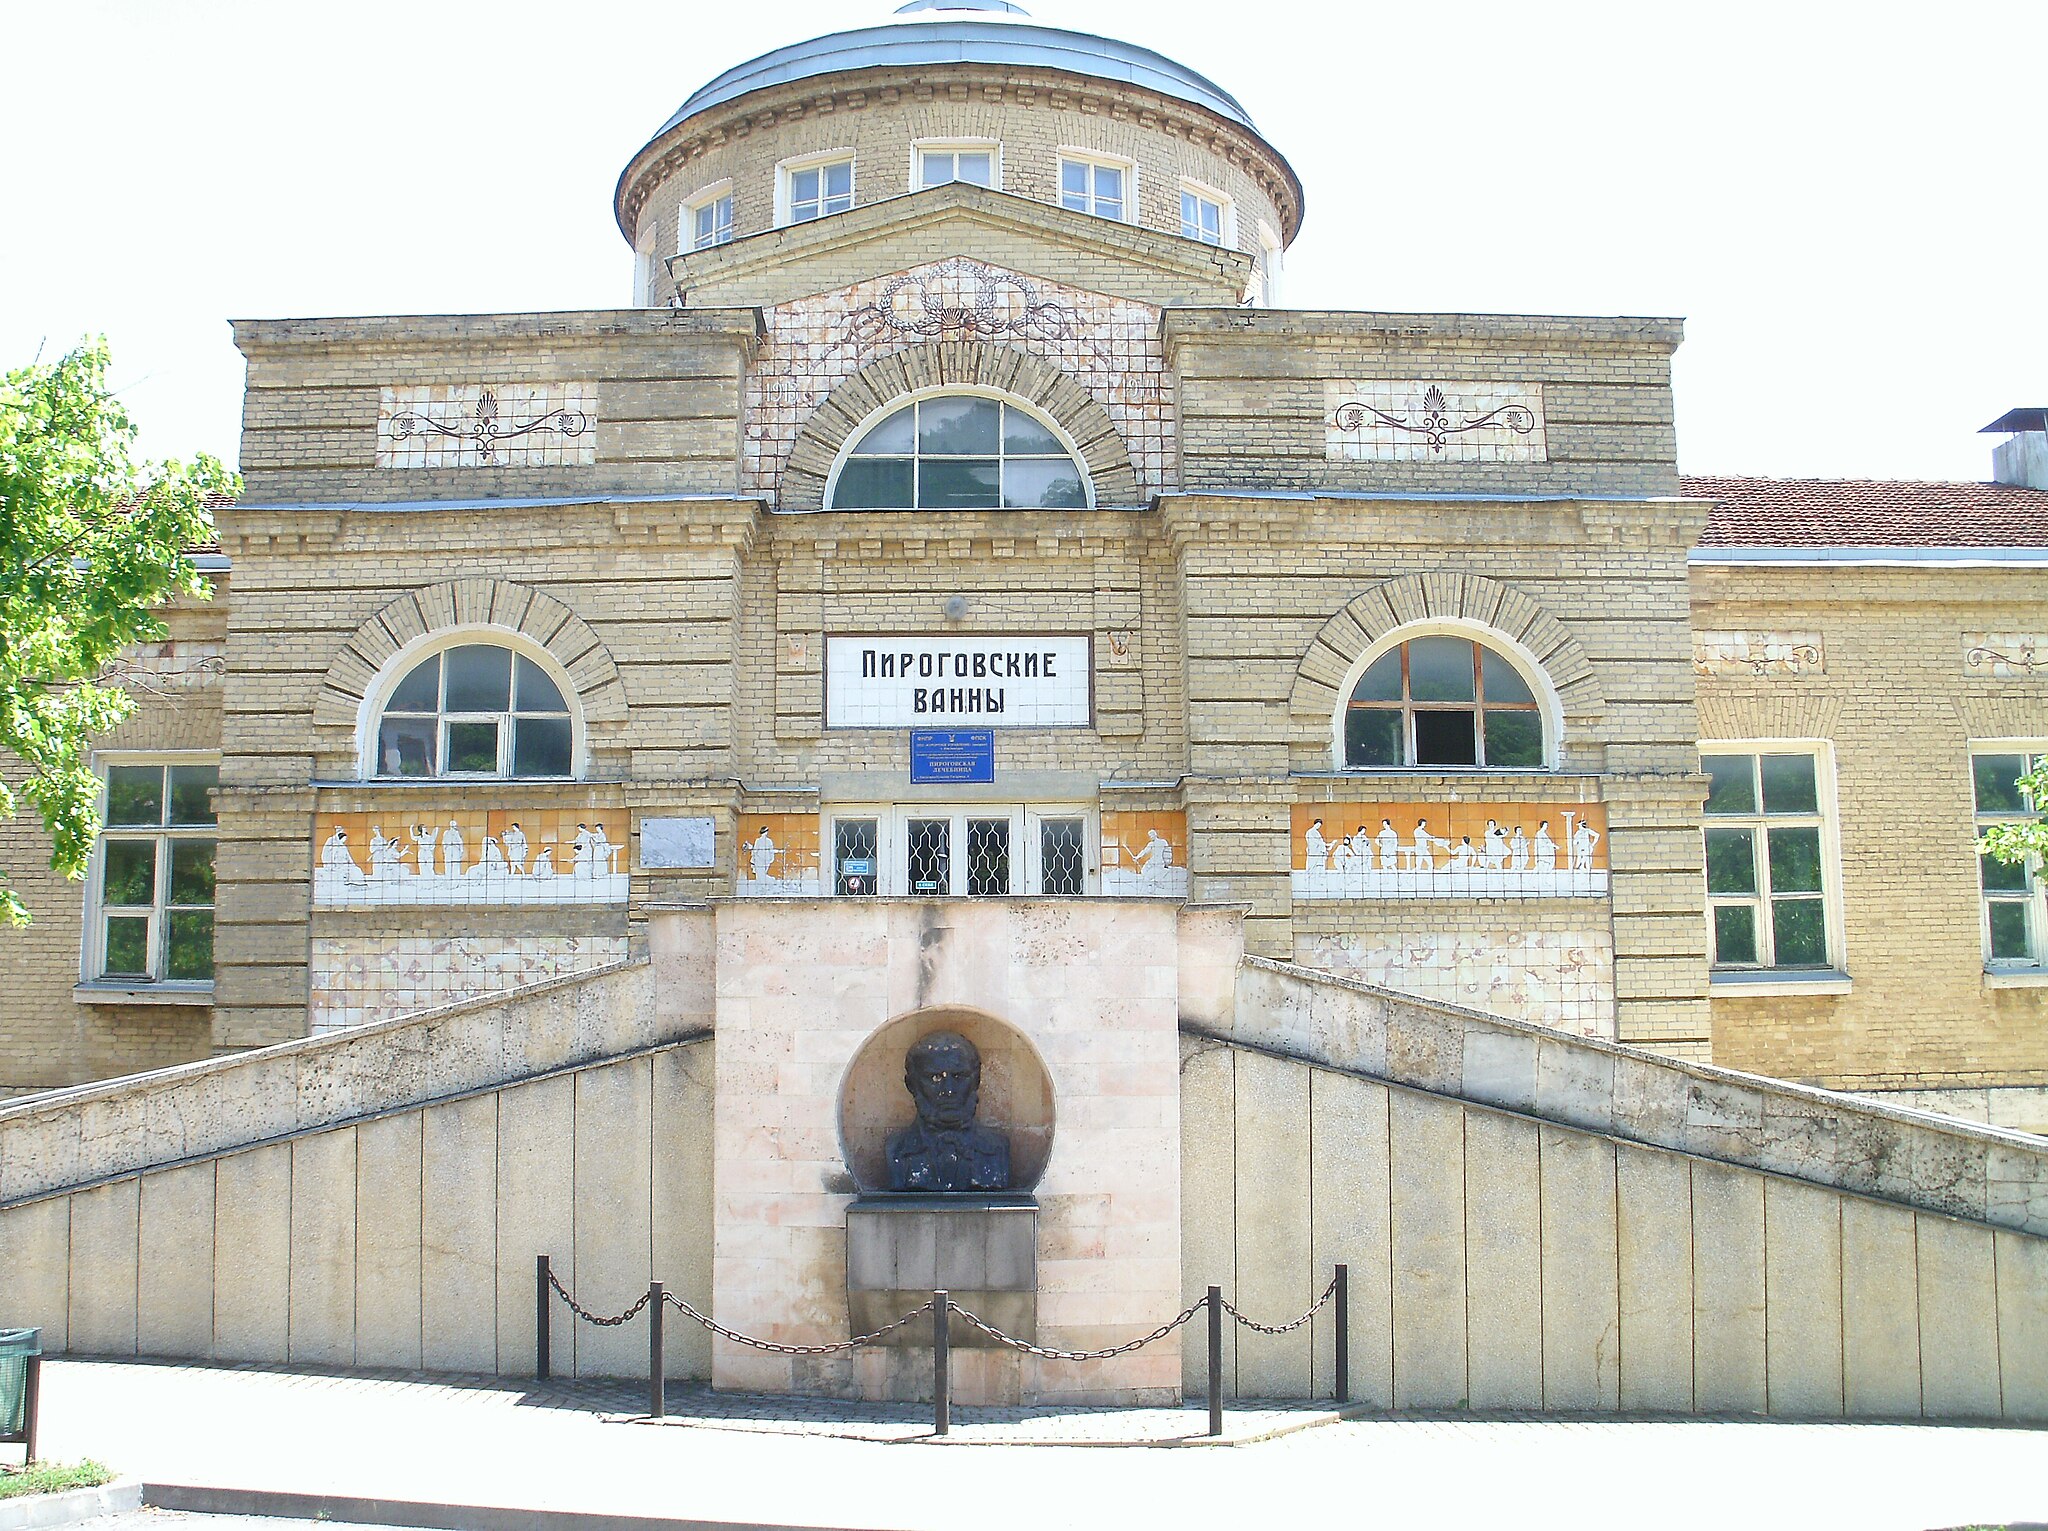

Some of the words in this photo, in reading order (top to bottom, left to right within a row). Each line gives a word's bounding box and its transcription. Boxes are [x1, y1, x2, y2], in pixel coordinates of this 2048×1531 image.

[766, 382, 799, 402] 1913
[862, 650, 1056, 678] ПИРОГОВСКИЕ
[914, 688, 1005, 713] ВАННЫ
